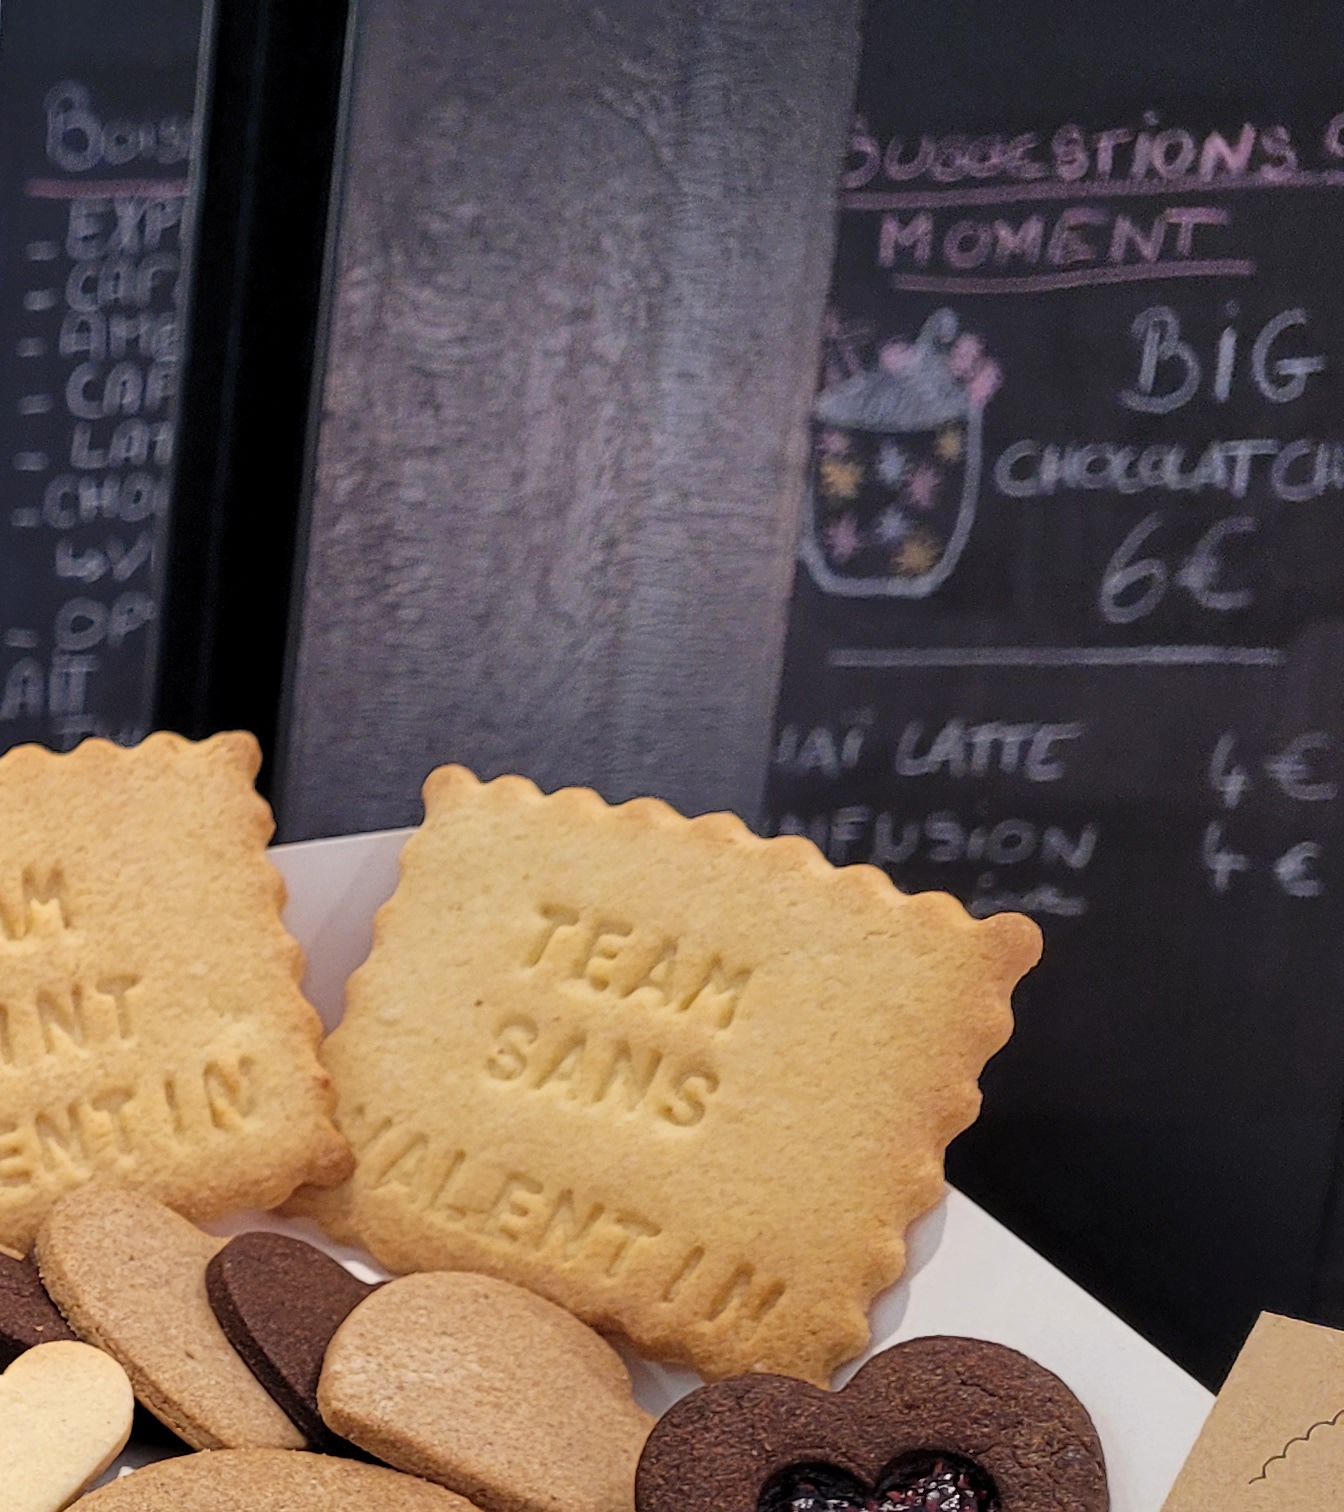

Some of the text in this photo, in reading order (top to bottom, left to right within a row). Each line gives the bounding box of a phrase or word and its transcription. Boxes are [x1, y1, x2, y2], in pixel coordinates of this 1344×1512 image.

[878, 206, 1232, 268] MOMENT
[894, 716, 1084, 783] LATTE
[520, 902, 756, 1030] TEAM
[484, 1013, 722, 1128] SANS
